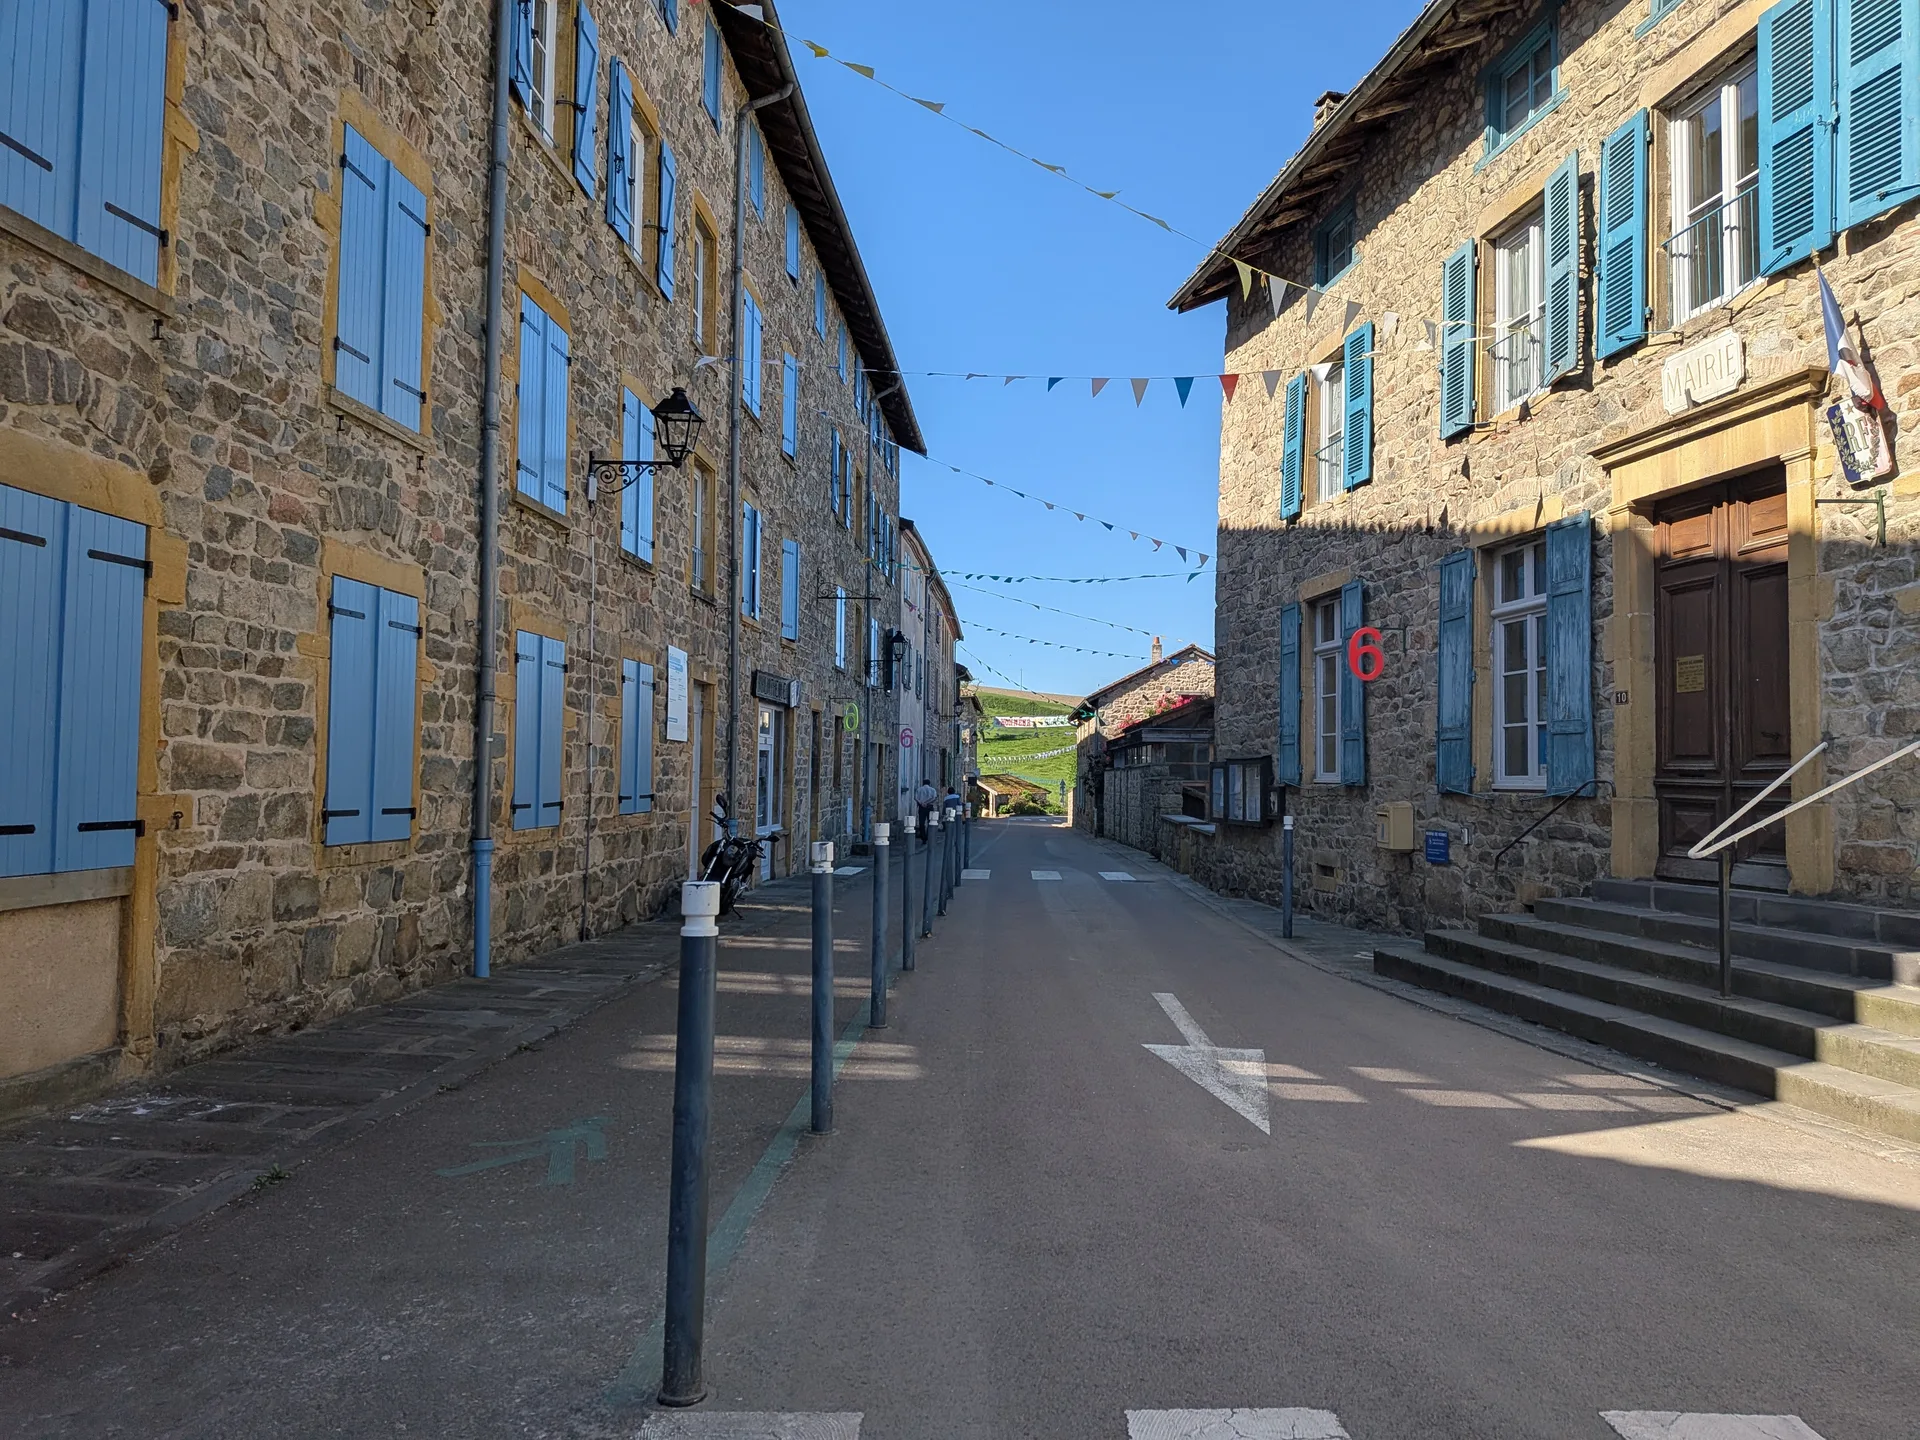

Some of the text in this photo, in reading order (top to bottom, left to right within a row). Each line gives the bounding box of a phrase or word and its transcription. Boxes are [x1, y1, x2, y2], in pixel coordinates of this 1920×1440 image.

[1665, 344, 1736, 401] MAIRIE
[1842, 416, 1869, 453] RF
[1348, 626, 1384, 681] 6
[1617, 692, 1627, 702] 10
[900, 727, 914, 748] 6
